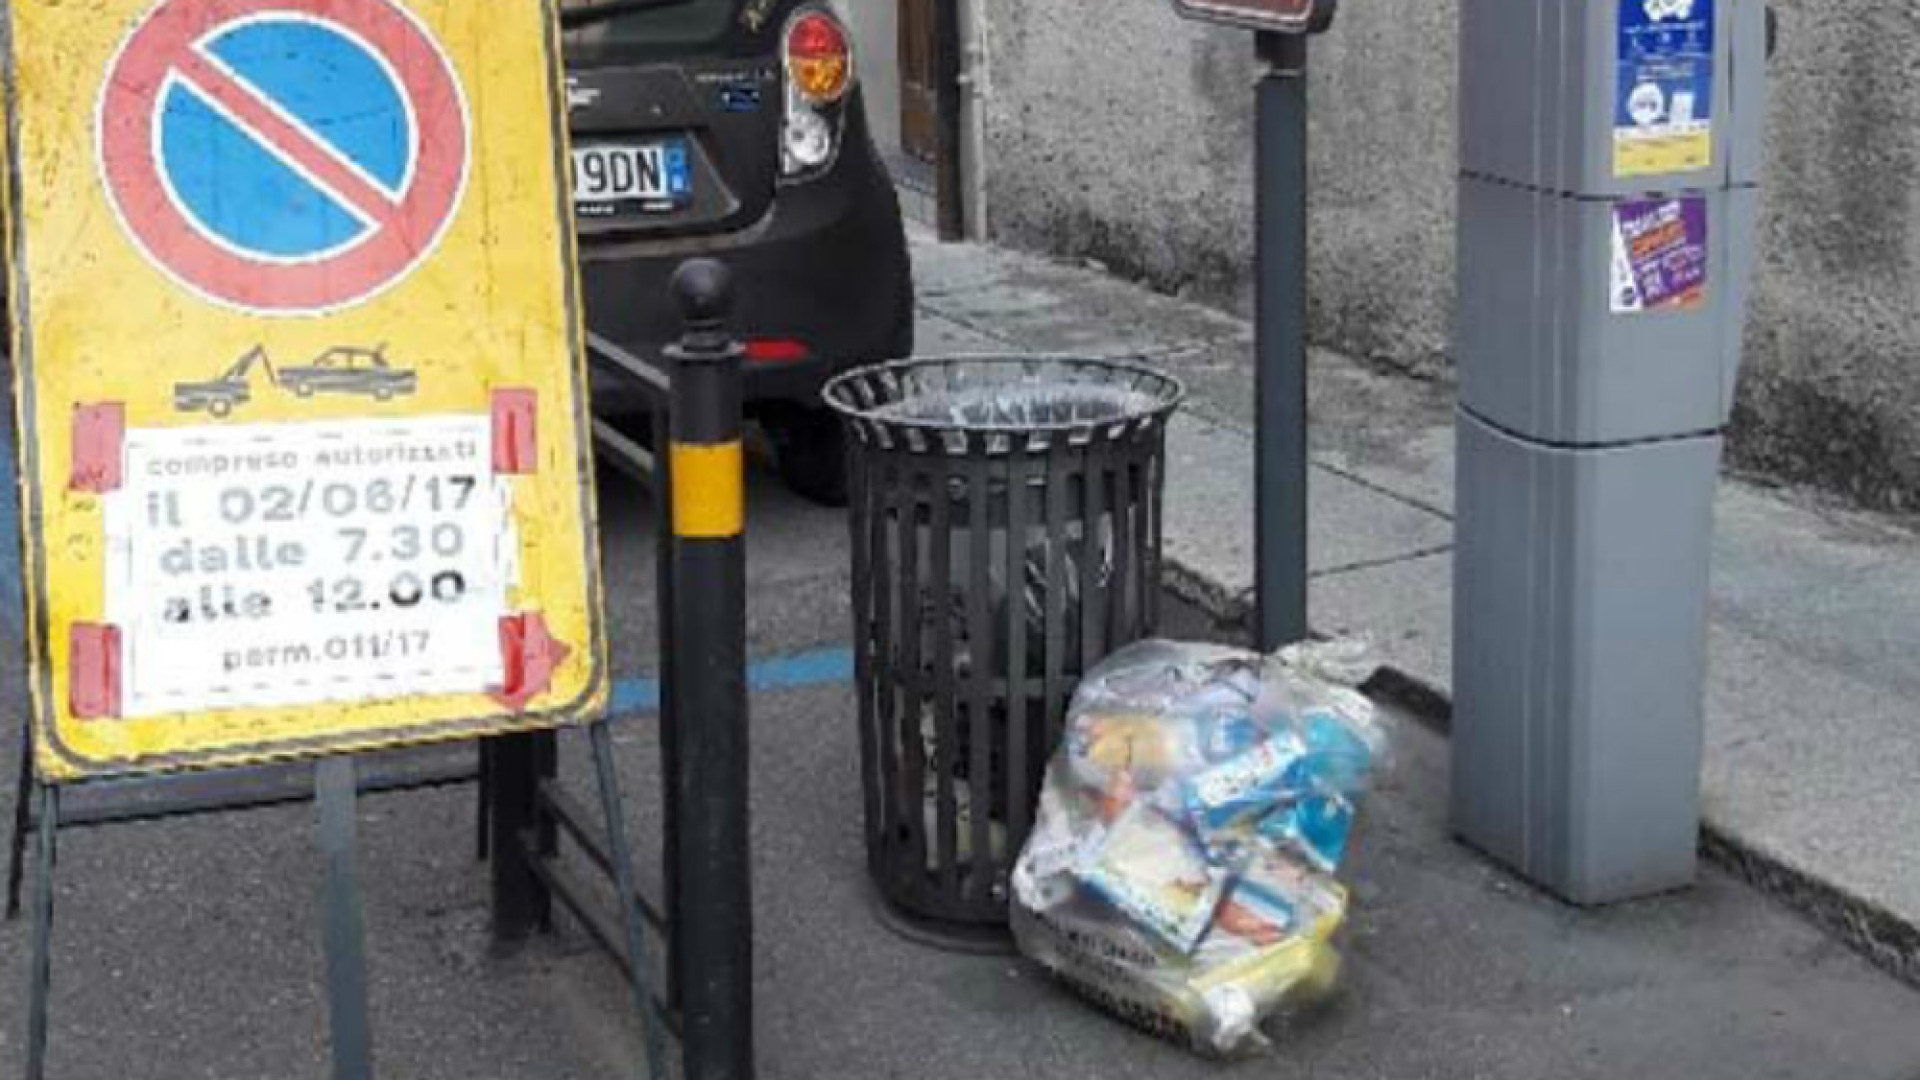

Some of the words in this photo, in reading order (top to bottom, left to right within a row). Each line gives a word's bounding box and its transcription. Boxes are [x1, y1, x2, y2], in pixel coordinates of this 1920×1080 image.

[571, 151, 661, 193] 9DN
[147, 489, 182, 529] il
[159, 533, 306, 576] dalle
[336, 522, 464, 564] 7.30
[305, 569, 467, 614] 12.00
